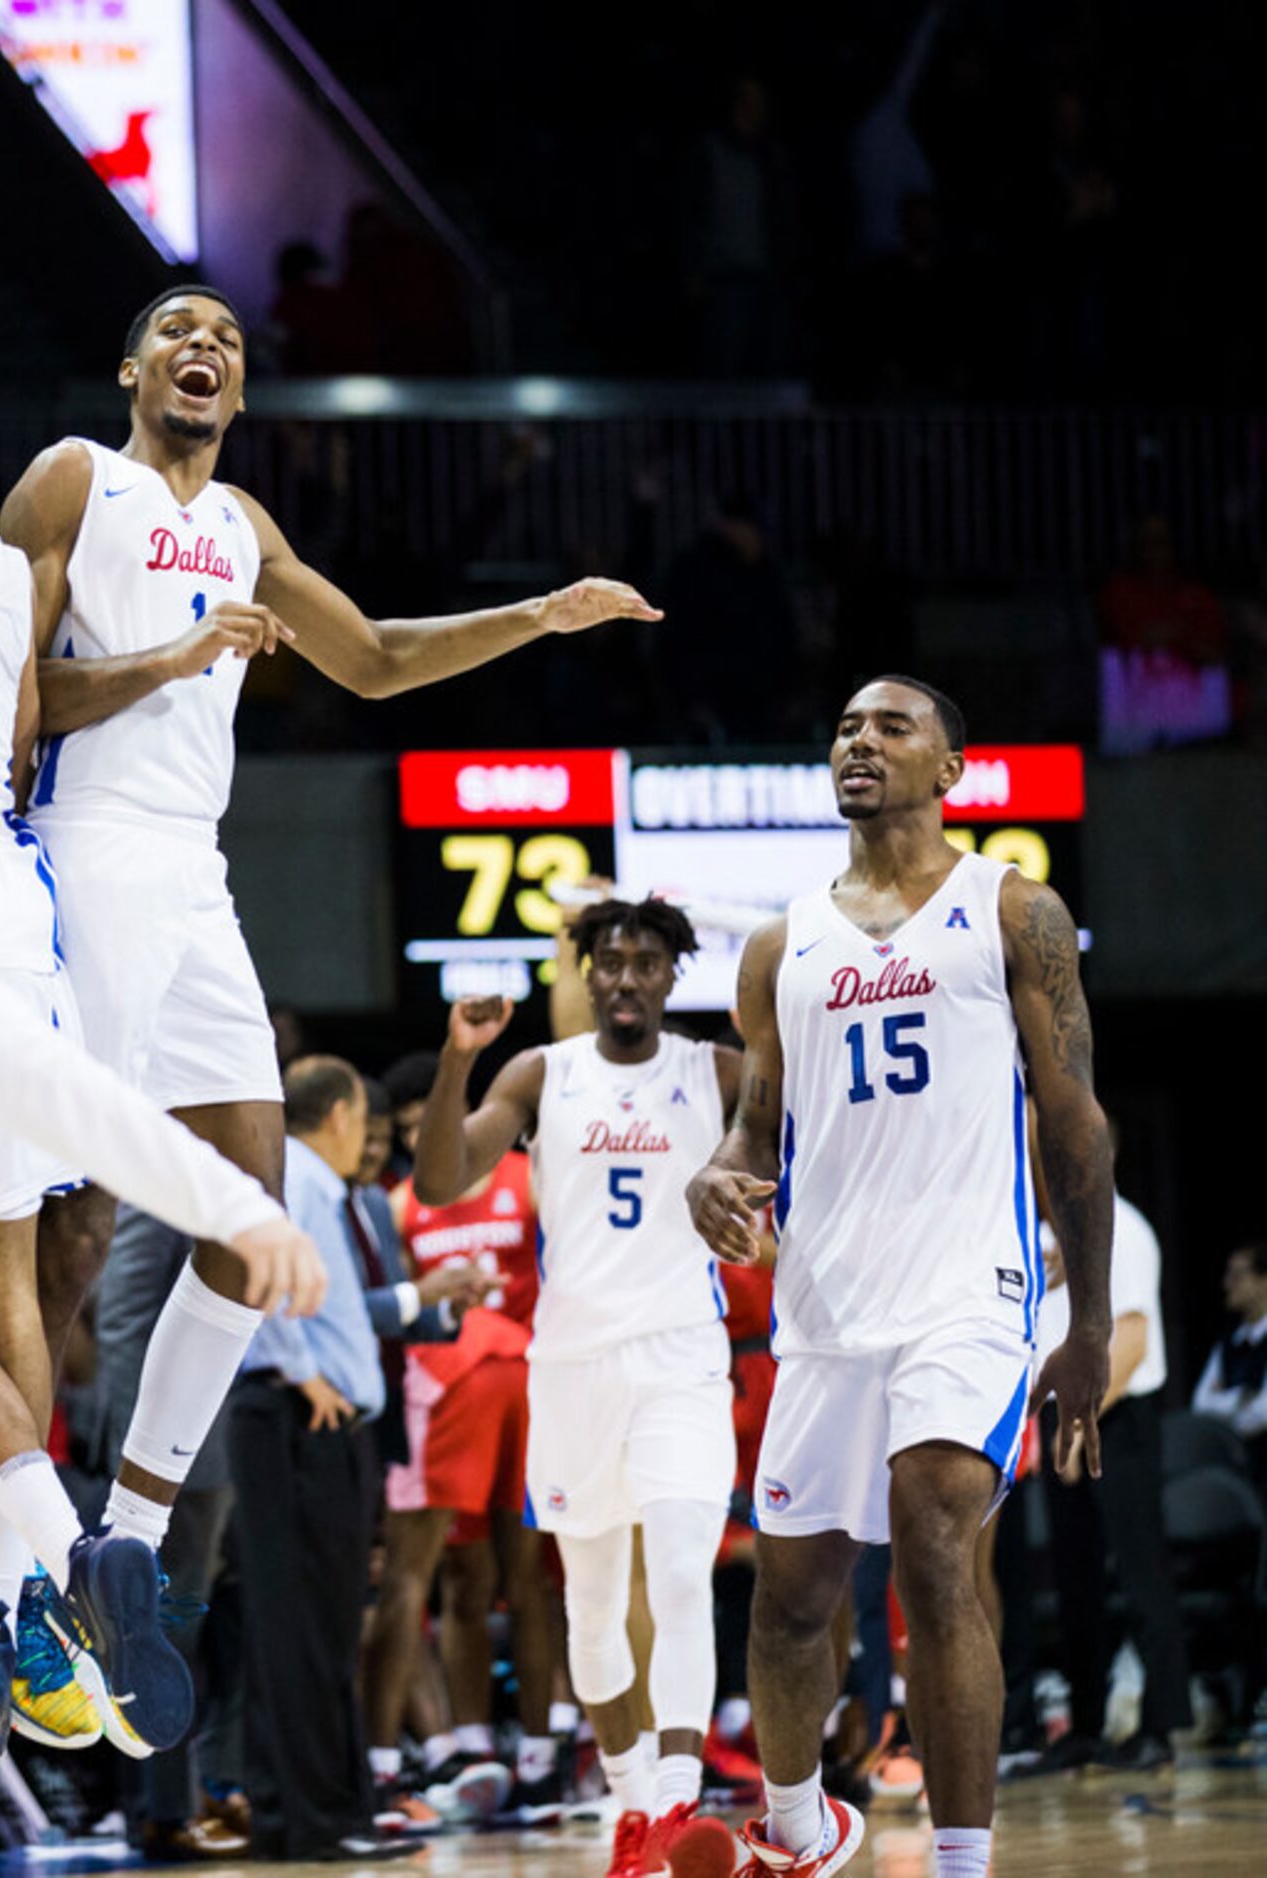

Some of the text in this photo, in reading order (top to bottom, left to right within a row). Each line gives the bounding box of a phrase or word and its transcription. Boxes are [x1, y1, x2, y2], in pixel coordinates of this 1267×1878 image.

[146, 527, 234, 582] Dallas
[633, 763, 837, 829] OVERTIM
[441, 834, 591, 936] 73
[826, 957, 936, 1011] Dallas
[845, 1011, 930, 1104] 15
[581, 1119, 671, 1153] Dallas
[608, 1167, 643, 1229] 5
